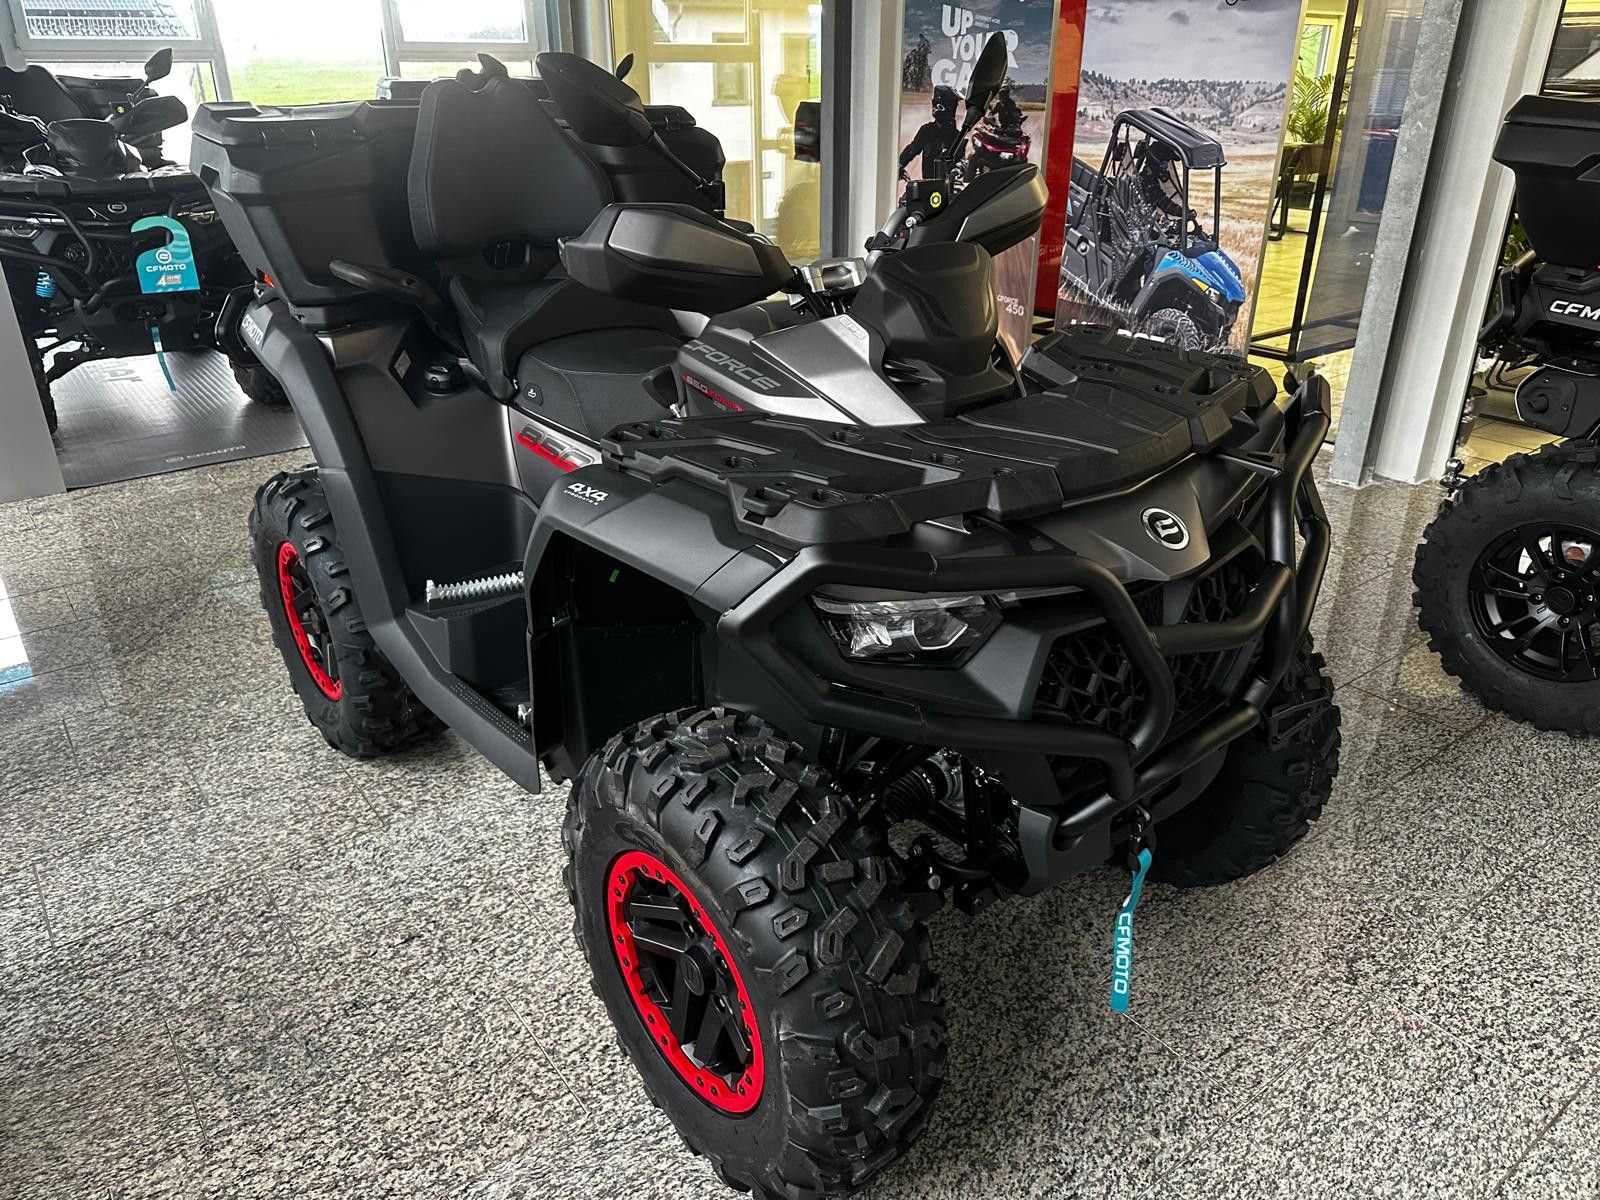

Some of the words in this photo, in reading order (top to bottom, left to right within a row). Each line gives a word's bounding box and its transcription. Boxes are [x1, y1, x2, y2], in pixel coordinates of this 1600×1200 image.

[942, 4, 974, 37] UP
[145, 263, 187, 273] CFMOTO
[1005, 303, 1025, 317] 450
[1113, 912, 1131, 995] CFMOTO
